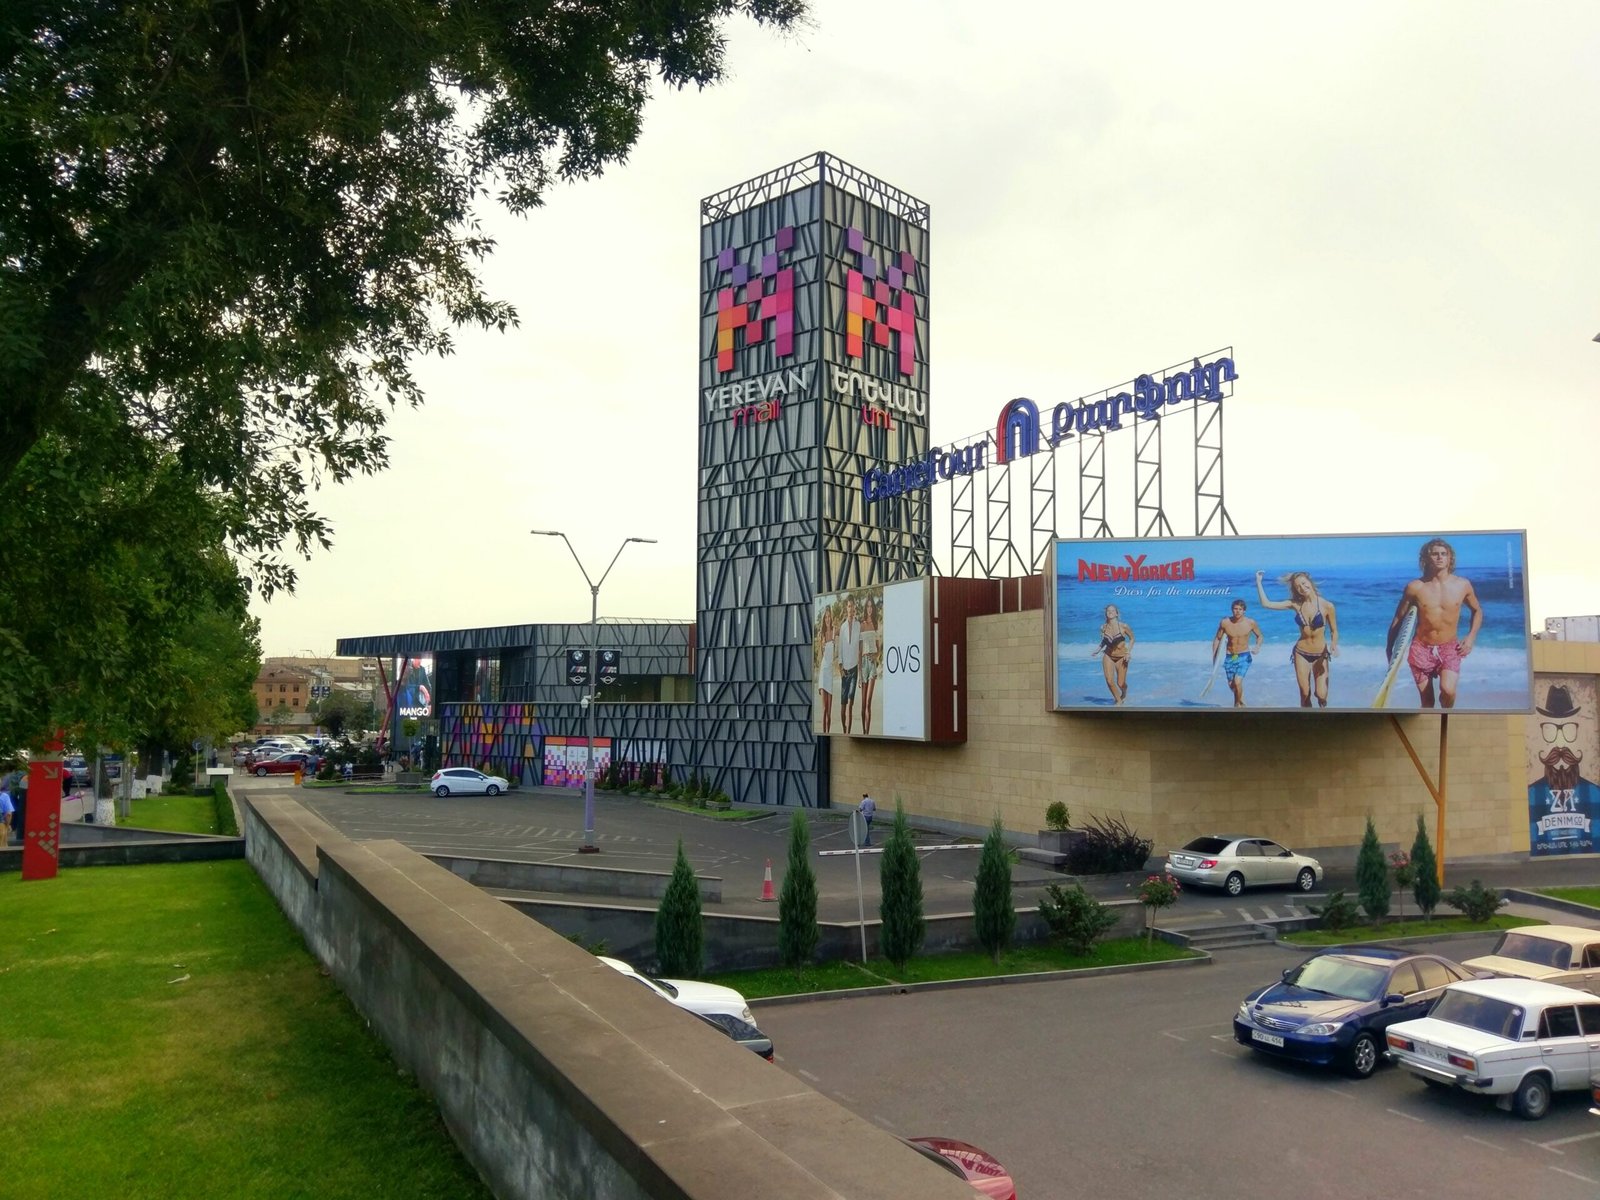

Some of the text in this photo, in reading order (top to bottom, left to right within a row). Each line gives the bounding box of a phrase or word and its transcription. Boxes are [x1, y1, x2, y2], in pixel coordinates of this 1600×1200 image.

[704, 367, 808, 412] YEREVAN
[834, 366, 926, 417] ԵՐԵՎԱՆ
[1048, 357, 1240, 448] Քարֆուր
[732, 399, 781, 428] mall
[863, 440, 989, 503] Carrefour
[1113, 585, 1143, 596] Dress
[1146, 585, 1161, 598] for
[1166, 585, 1181, 596] the
[886, 644, 921, 674] OVS
[399, 707, 429, 717] MANGO
